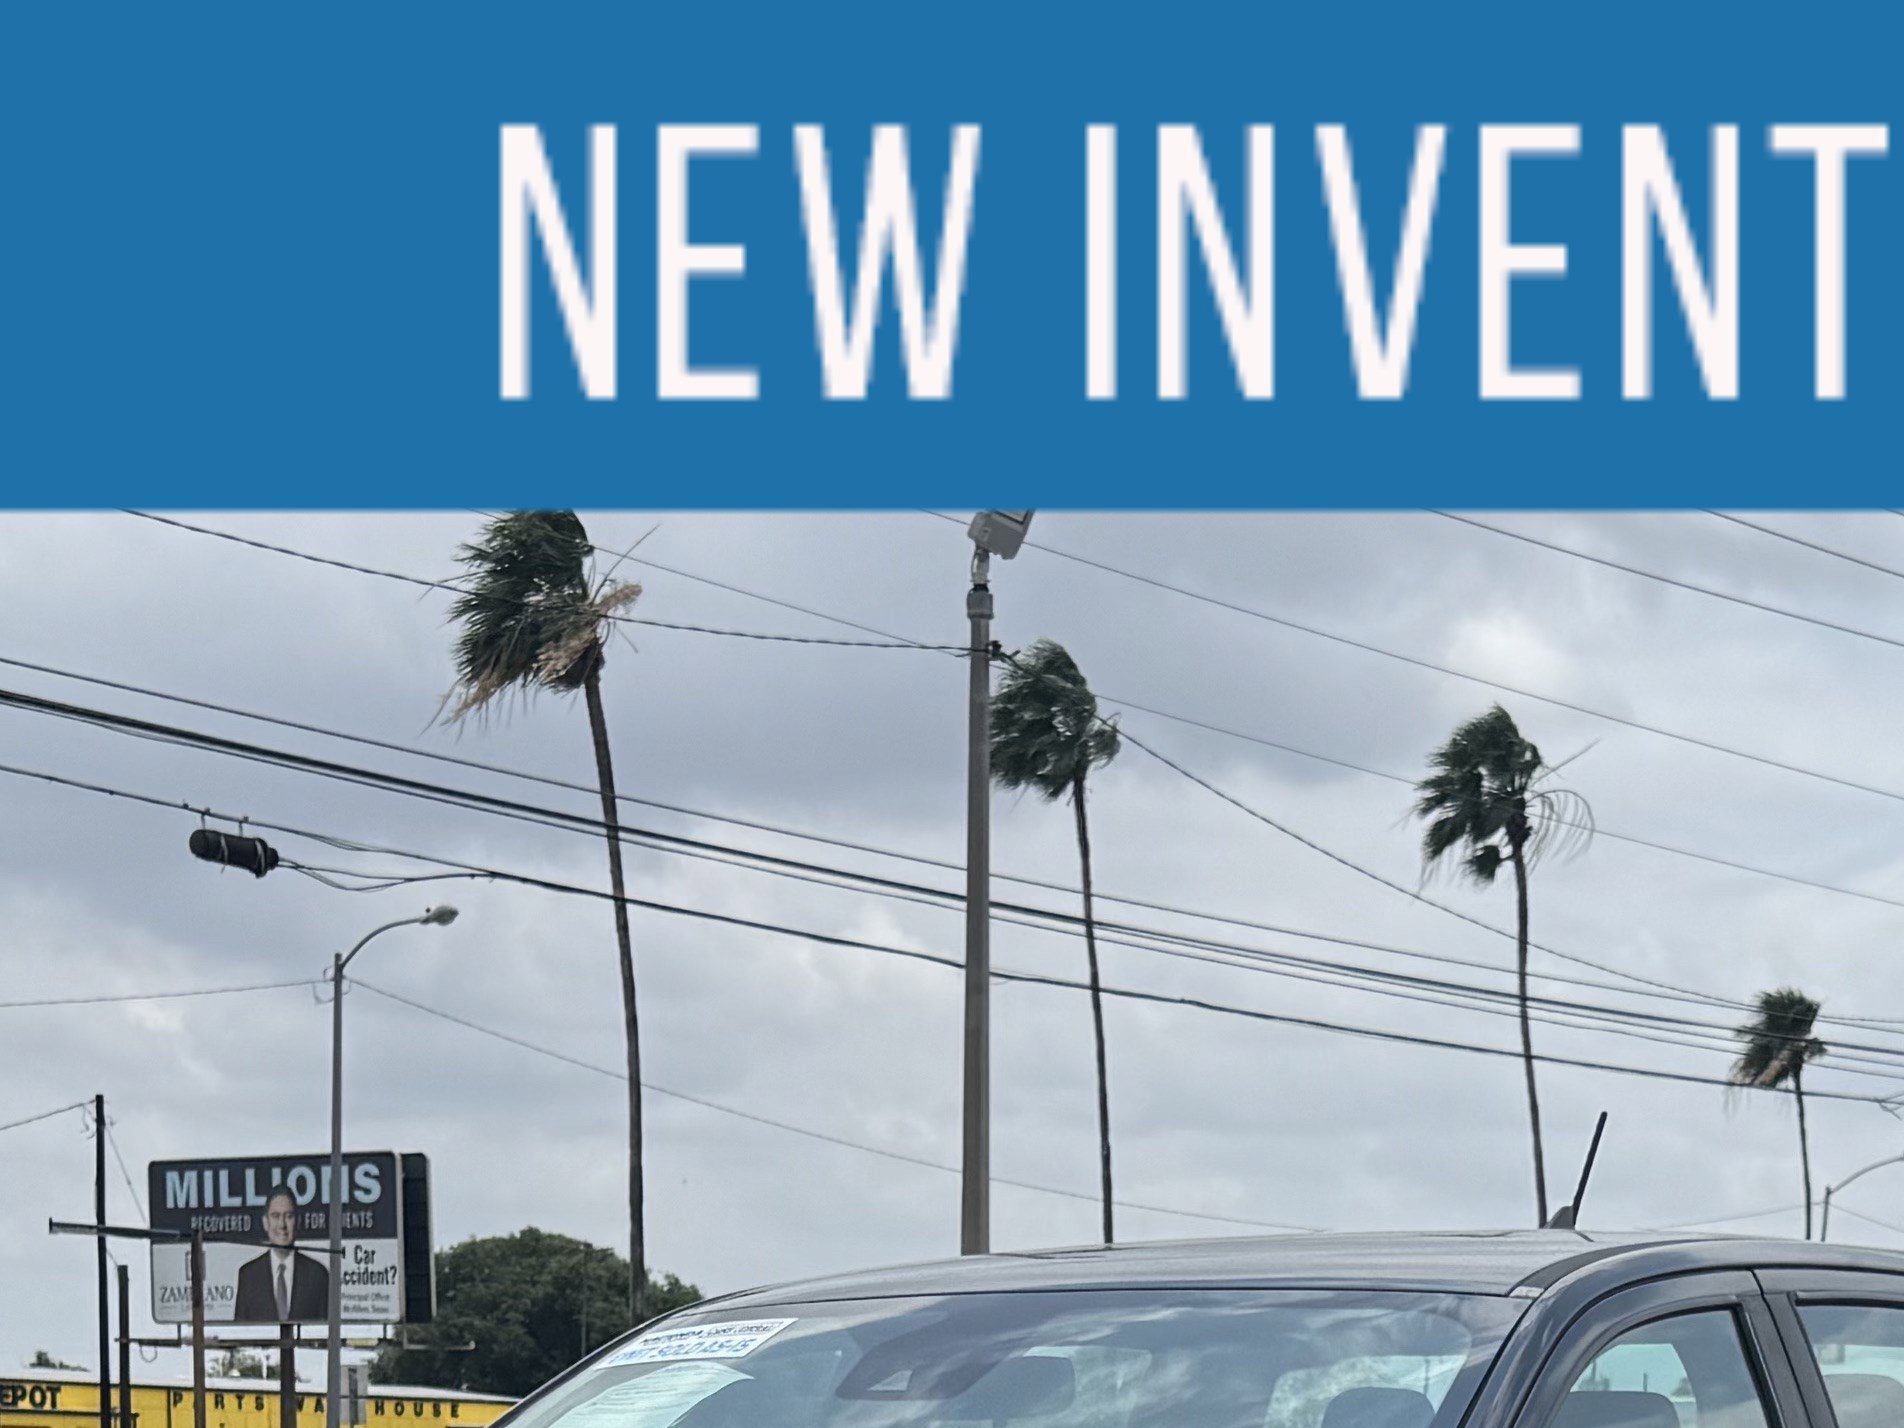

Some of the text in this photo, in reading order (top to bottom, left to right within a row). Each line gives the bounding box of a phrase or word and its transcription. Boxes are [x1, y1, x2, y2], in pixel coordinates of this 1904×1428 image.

[305, 1211, 326, 1229] FOR
[354, 1244, 376, 1265] Car
[342, 1266, 397, 1286] ccident?
[160, 1285, 234, 1303] ZAMANO
[172, 1391, 265, 1412] PRTS
